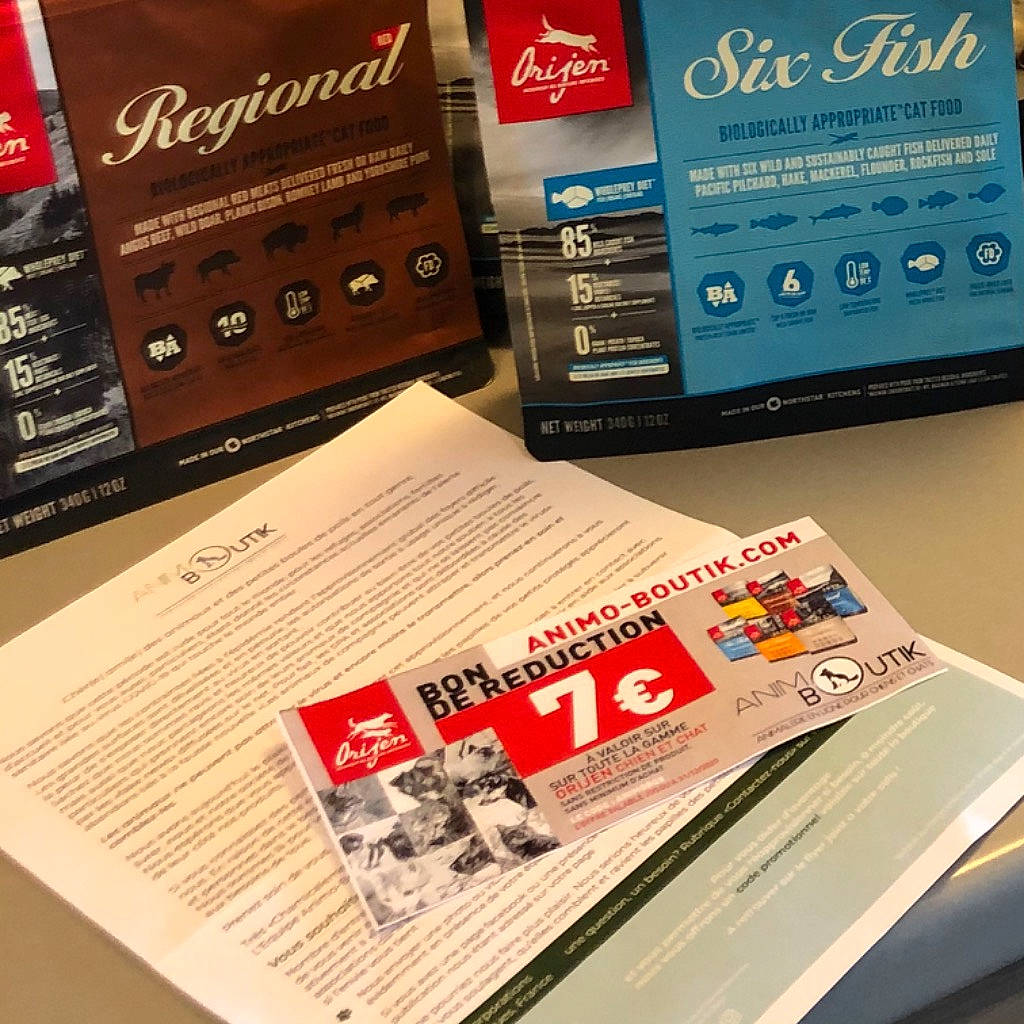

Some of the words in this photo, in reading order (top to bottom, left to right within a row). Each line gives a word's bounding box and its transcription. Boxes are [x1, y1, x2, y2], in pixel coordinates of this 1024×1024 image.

[511, 46, 610, 104] Orijen
[683, 27, 811, 100] Six
[821, 12, 986, 83] Fish
[102, 23, 411, 165] Regional
[718, 115, 807, 142] BIOLOGICALLY
[903, 101, 928, 120] CAT
[929, 96, 963, 117] FOOD
[783, 155, 803, 170] AND
[903, 140, 924, 156] FISH
[925, 134, 972, 153] DELIVERED
[973, 130, 999, 147] DAILY
[954, 149, 973, 165] AND
[975, 146, 996, 162] SOLE
[783, 268, 801, 292] 6
[540, 419, 560, 434] NET
[564, 417, 603, 433] WEIGHT
[0, 516, 10, 535] ET
[12, 500, 57, 529] WEIGHT
[523, 526, 802, 654] ANIMO-BOUTIK.COM
[415, 660, 490, 706] BON
[424, 687, 475, 723] DE
[478, 607, 667, 700] REDUCTION
[334, 728, 410, 769] Orijen
[548, 772, 577, 791] SUR
[578, 752, 621, 778] TOUTE
[622, 743, 641, 758] LA
[640, 721, 689, 749] GAMME
[553, 766, 614, 801] ORIJEN
[613, 746, 657, 773] CHIEN
[657, 738, 674, 753] ET
[676, 722, 709, 744] CHAT
[596, 731, 644, 759] VALOIR
[643, 719, 671, 738] SUR
[559, 792, 583, 807] SANS
[584, 767, 641, 797] RESTRICTION
[641, 761, 652, 771] DE
[563, 798, 588, 814] SANS
[588, 780, 629, 802] MINIMUM
[733, 868, 762, 895] code
[756, 812, 825, 873] promotionnel
